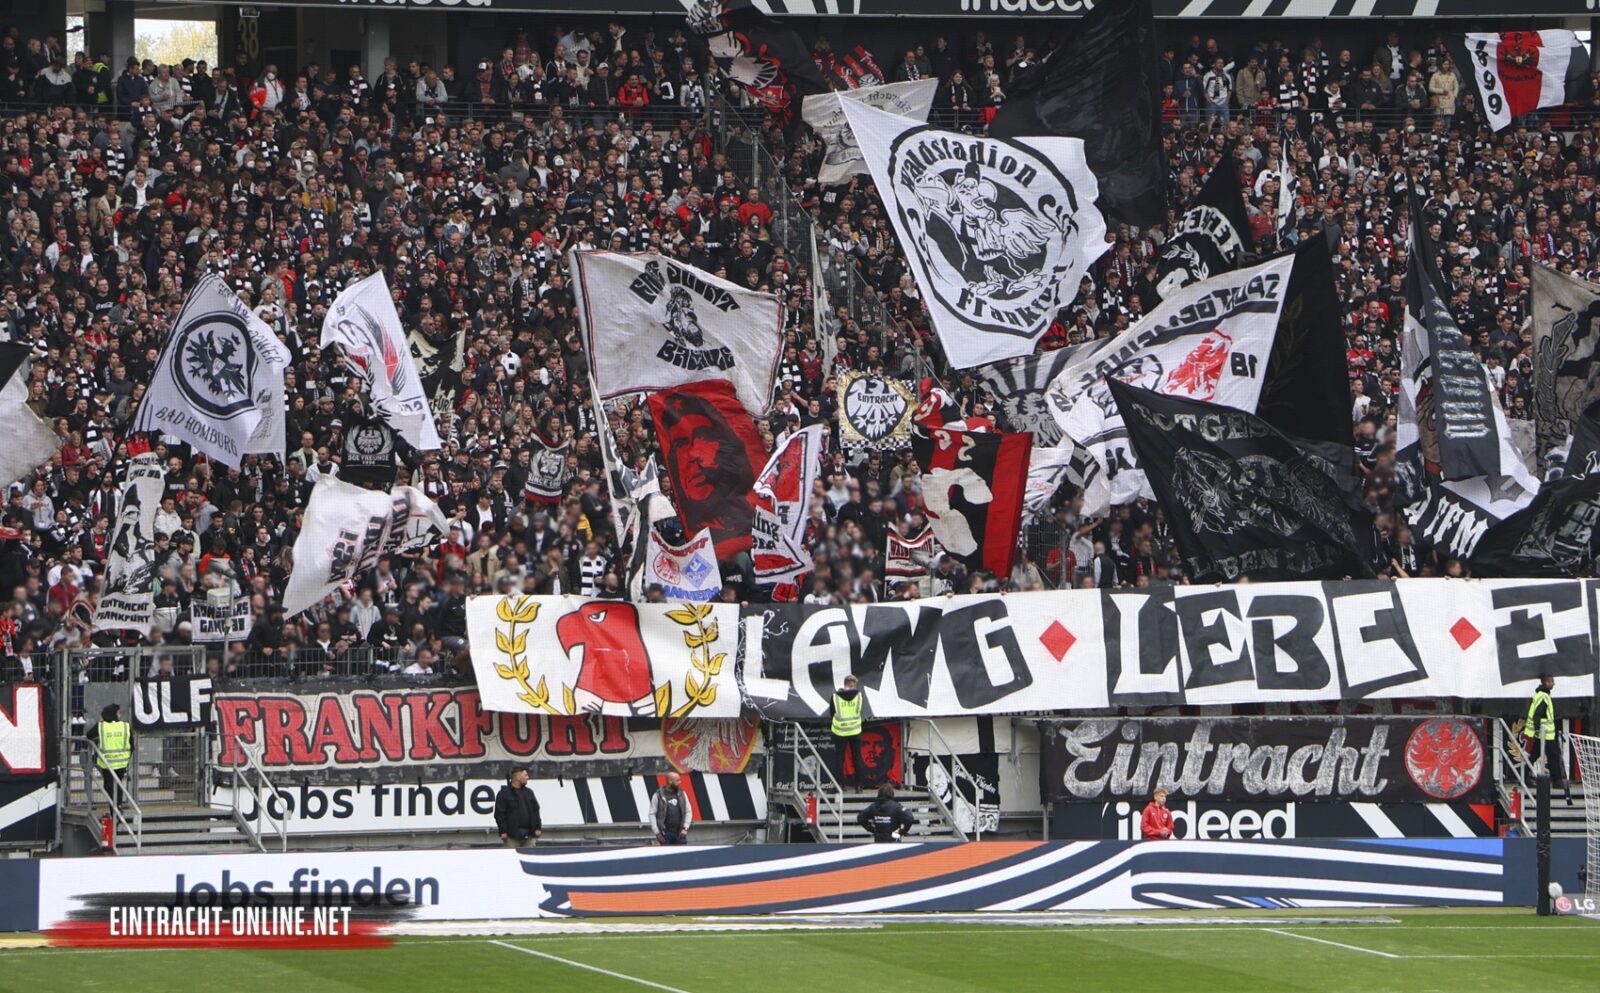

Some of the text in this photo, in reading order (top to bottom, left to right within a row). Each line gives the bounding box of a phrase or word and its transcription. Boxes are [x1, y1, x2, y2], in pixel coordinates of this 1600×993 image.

[155, 406, 238, 456] BAD HOMBURG
[1110, 587, 1429, 697] LEBE
[133, 677, 213, 726] ULF
[215, 690, 631, 768] FRANKFURT
[1058, 719, 1390, 799] Eintracht
[241, 779, 495, 821] Jobs finde
[1116, 801, 1295, 839] ideed
[166, 866, 439, 911] Jobs finden
